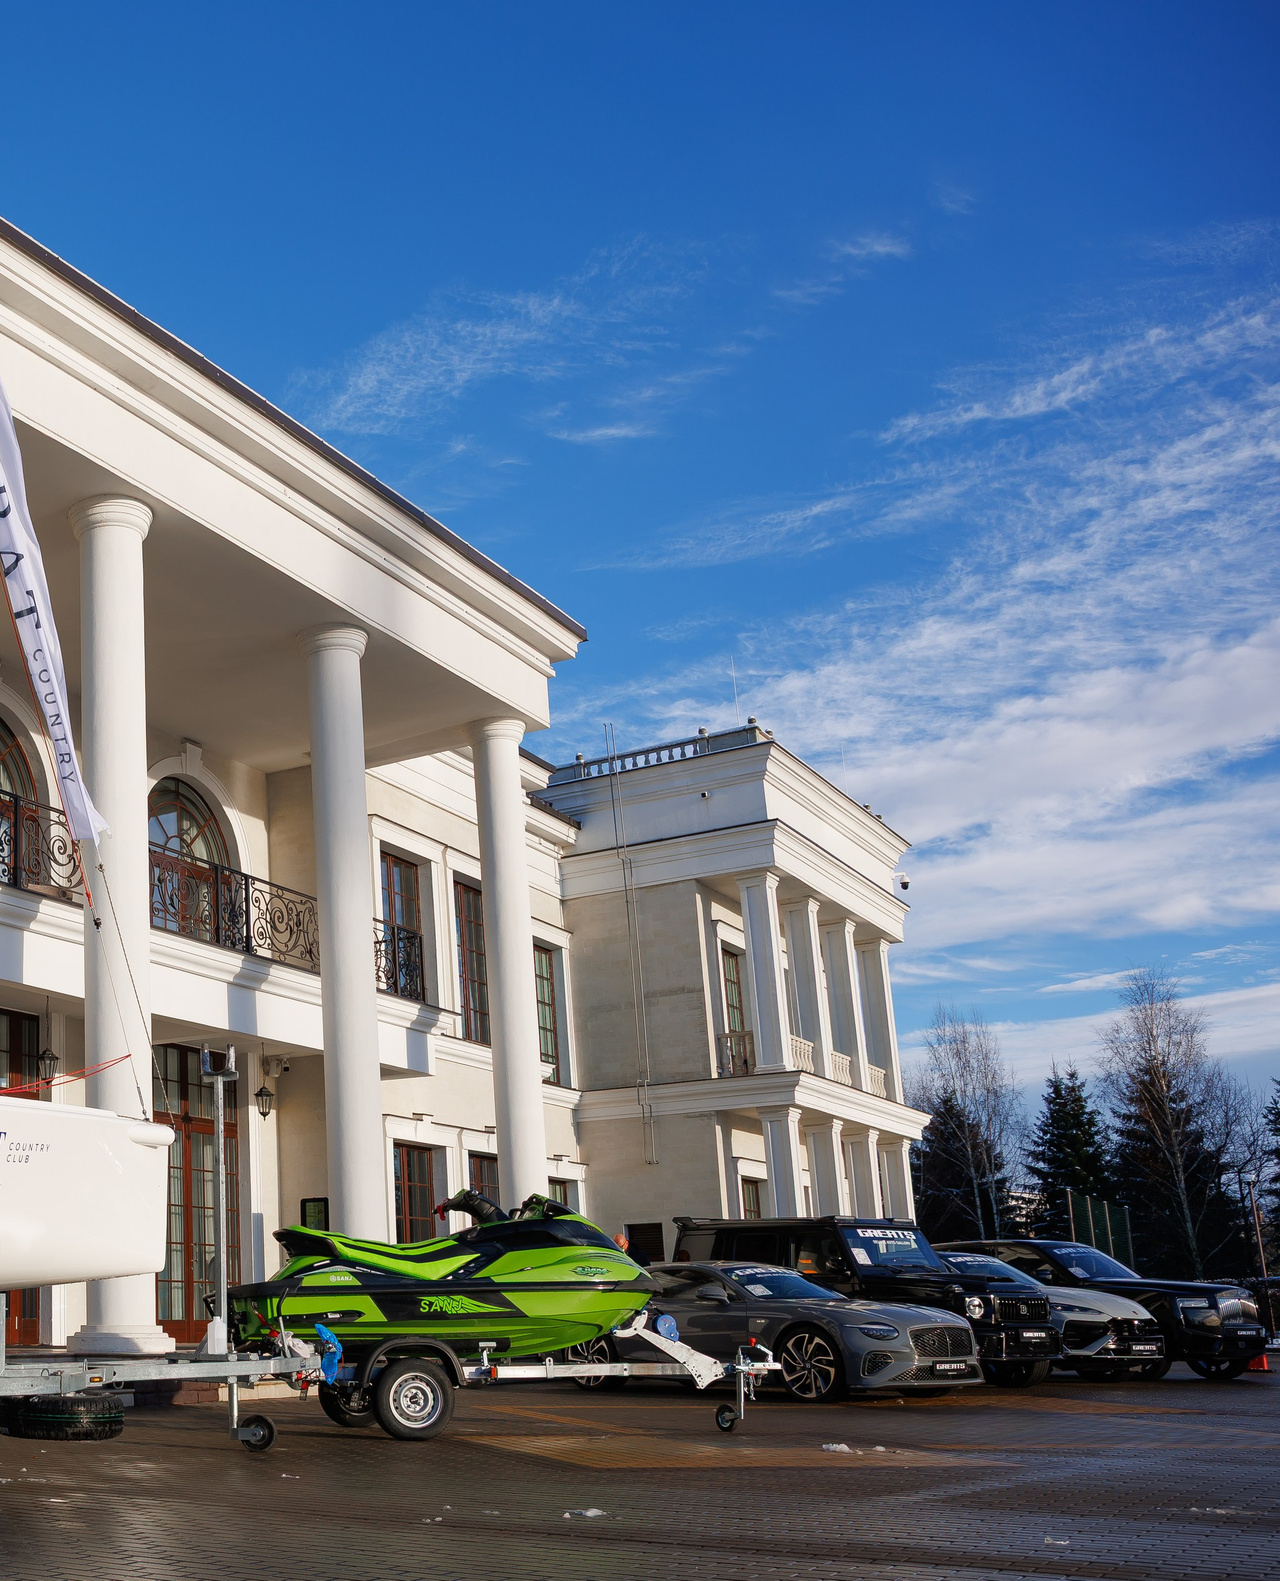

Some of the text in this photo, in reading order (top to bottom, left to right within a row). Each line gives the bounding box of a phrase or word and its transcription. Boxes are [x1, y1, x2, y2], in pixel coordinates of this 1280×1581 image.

[32, 648, 76, 783] COUNTRY
[8, 1142, 51, 1153] COUNTRY
[6, 1154, 31, 1164] CLUB
[420, 1299, 463, 1312] SANJ
